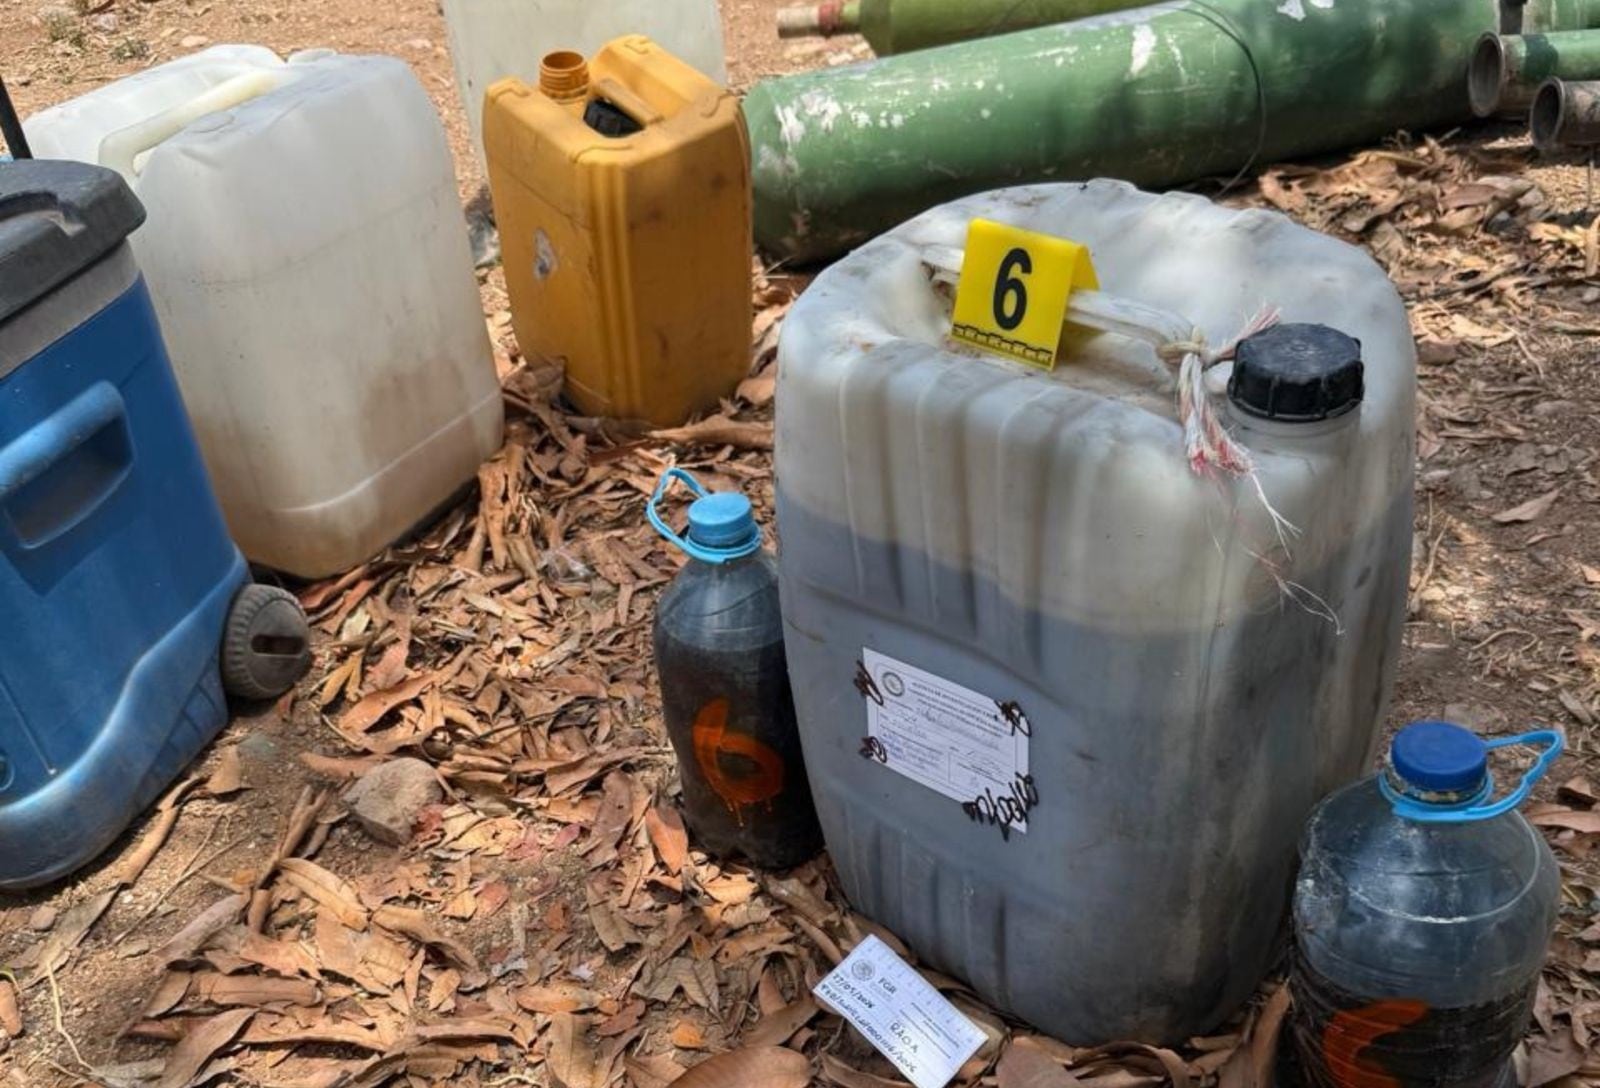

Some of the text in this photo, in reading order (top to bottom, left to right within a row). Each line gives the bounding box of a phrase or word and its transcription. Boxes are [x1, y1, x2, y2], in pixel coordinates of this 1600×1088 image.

[993, 247, 1033, 331] 6
[692, 697, 784, 806] 6
[879, 977, 897, 994] FGR
